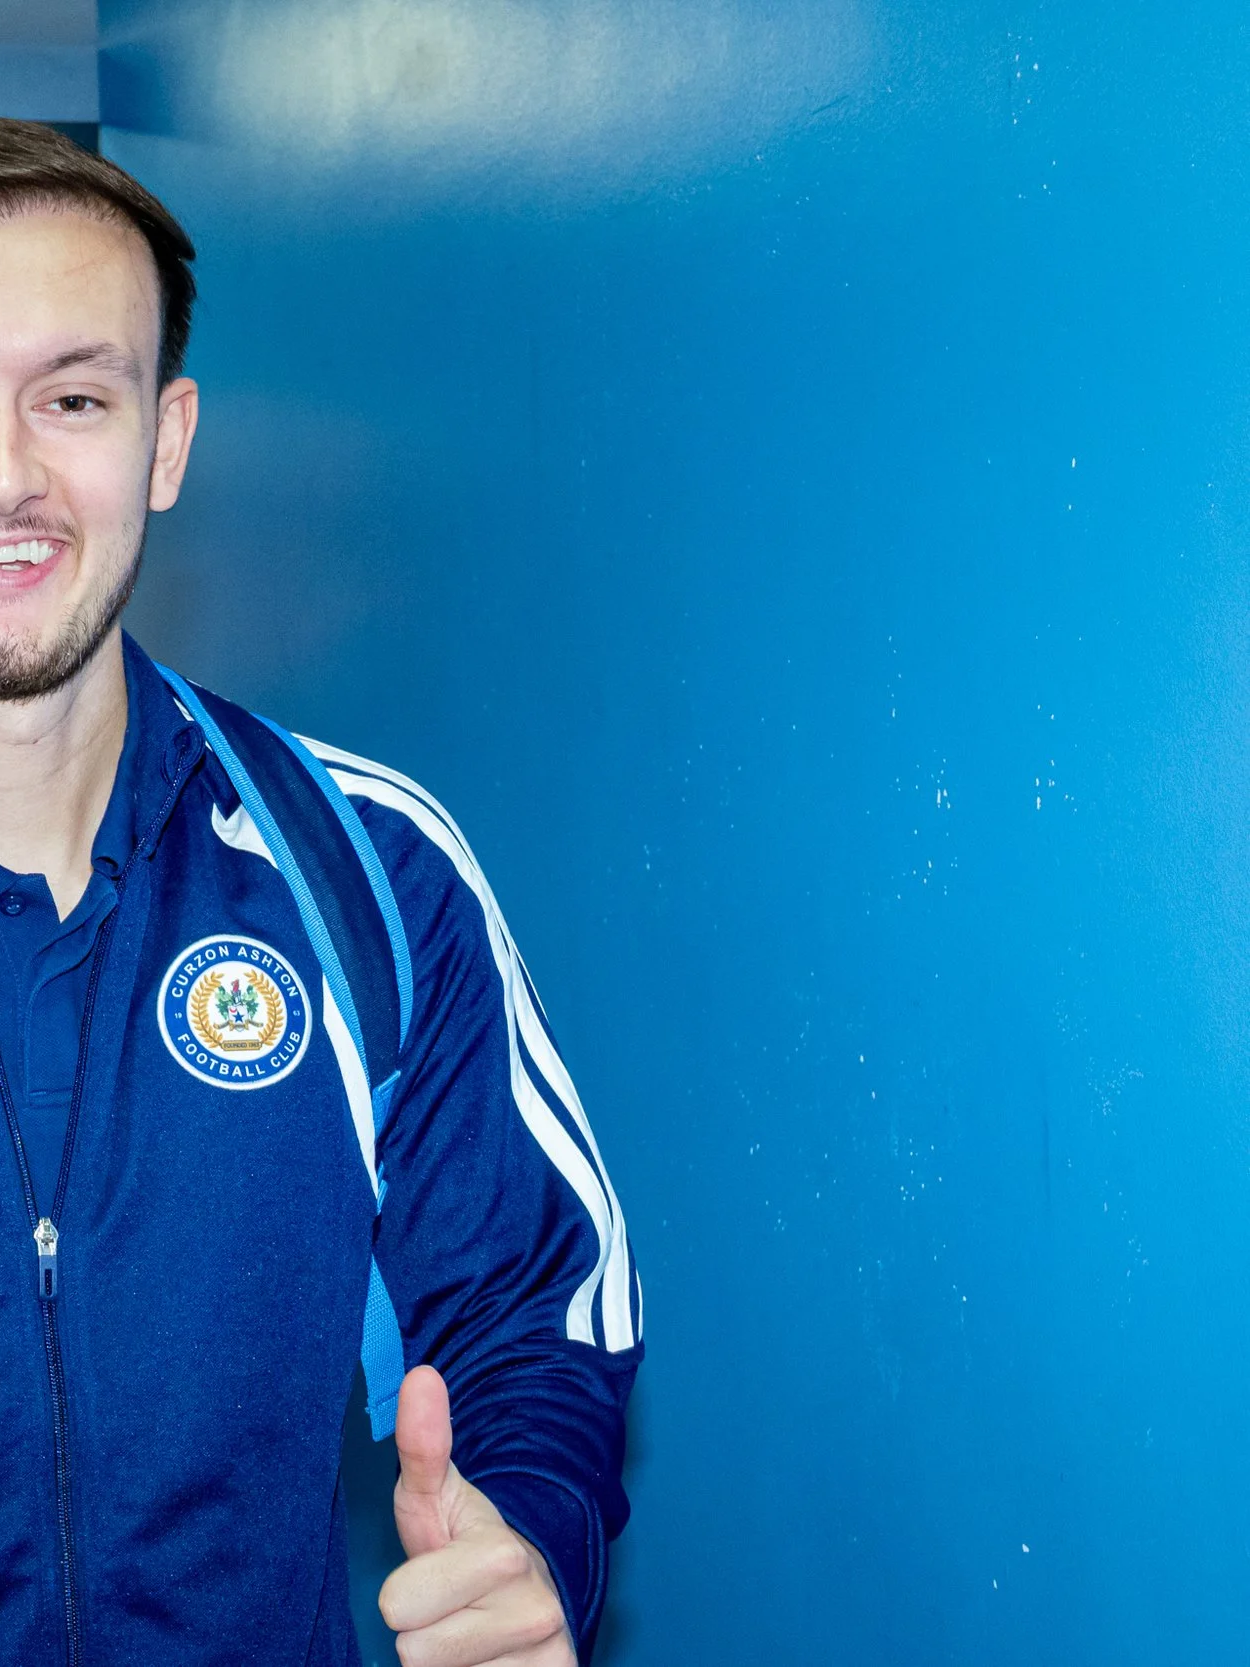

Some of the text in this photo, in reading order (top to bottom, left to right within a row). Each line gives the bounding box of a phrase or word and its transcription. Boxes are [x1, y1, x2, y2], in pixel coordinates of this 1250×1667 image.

[171, 945, 299, 998] CURZON ASHTON
[178, 1032, 301, 1077] FOOTBALL CLUB
